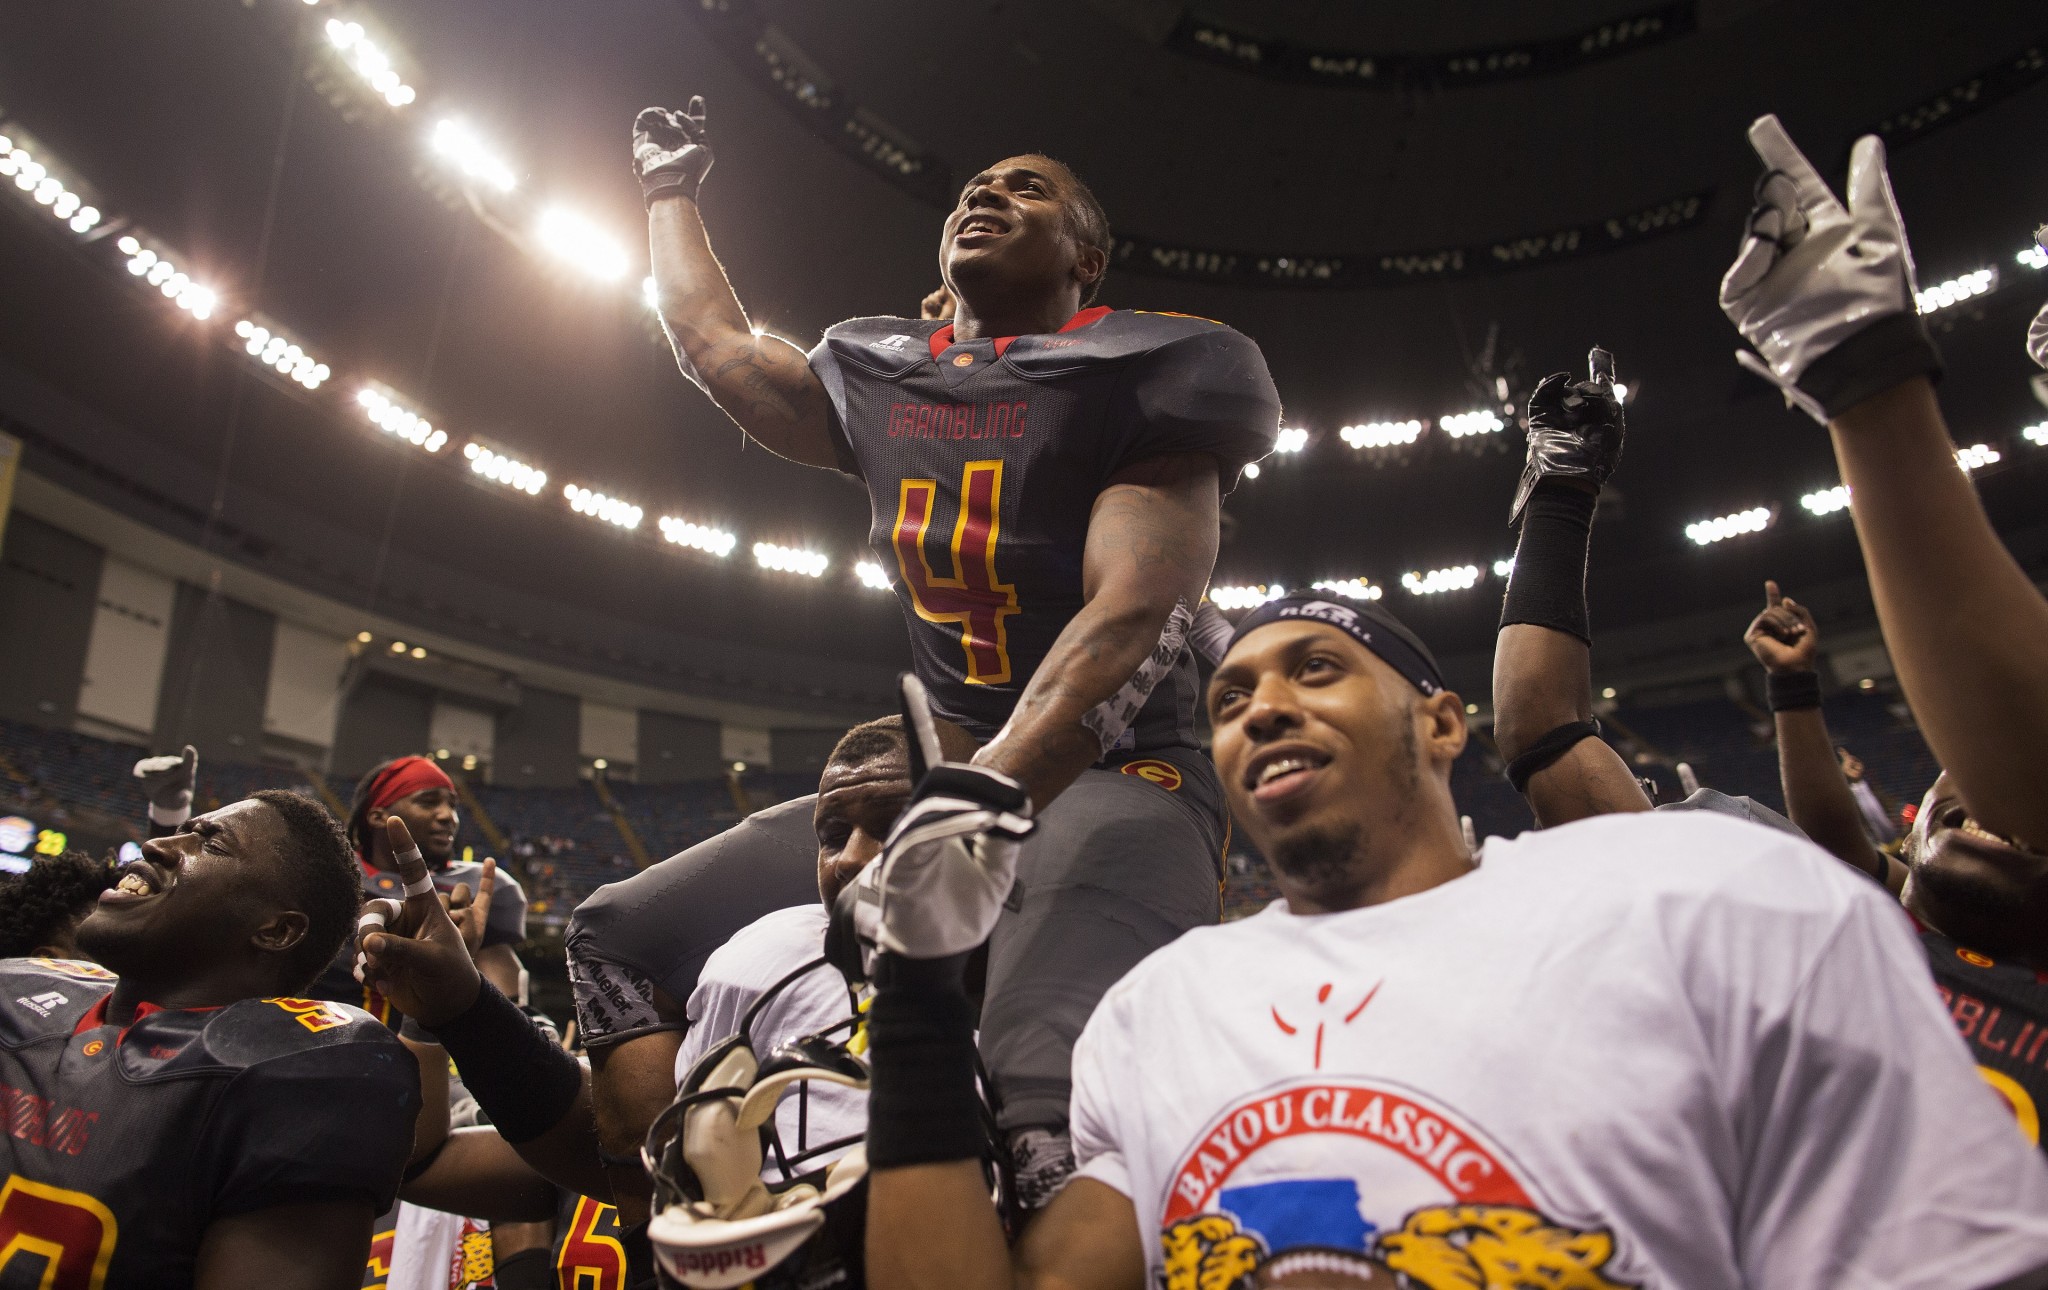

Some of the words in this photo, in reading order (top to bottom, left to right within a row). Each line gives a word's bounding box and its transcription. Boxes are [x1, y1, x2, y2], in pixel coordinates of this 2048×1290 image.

[887, 401, 1029, 440] GRAMBLING
[892, 458, 1022, 686] 4
[16, 996, 52, 1018] RUSSELL
[1177, 1095, 1295, 1209] BAYOU
[1300, 1088, 1493, 1195] CLASSIC
